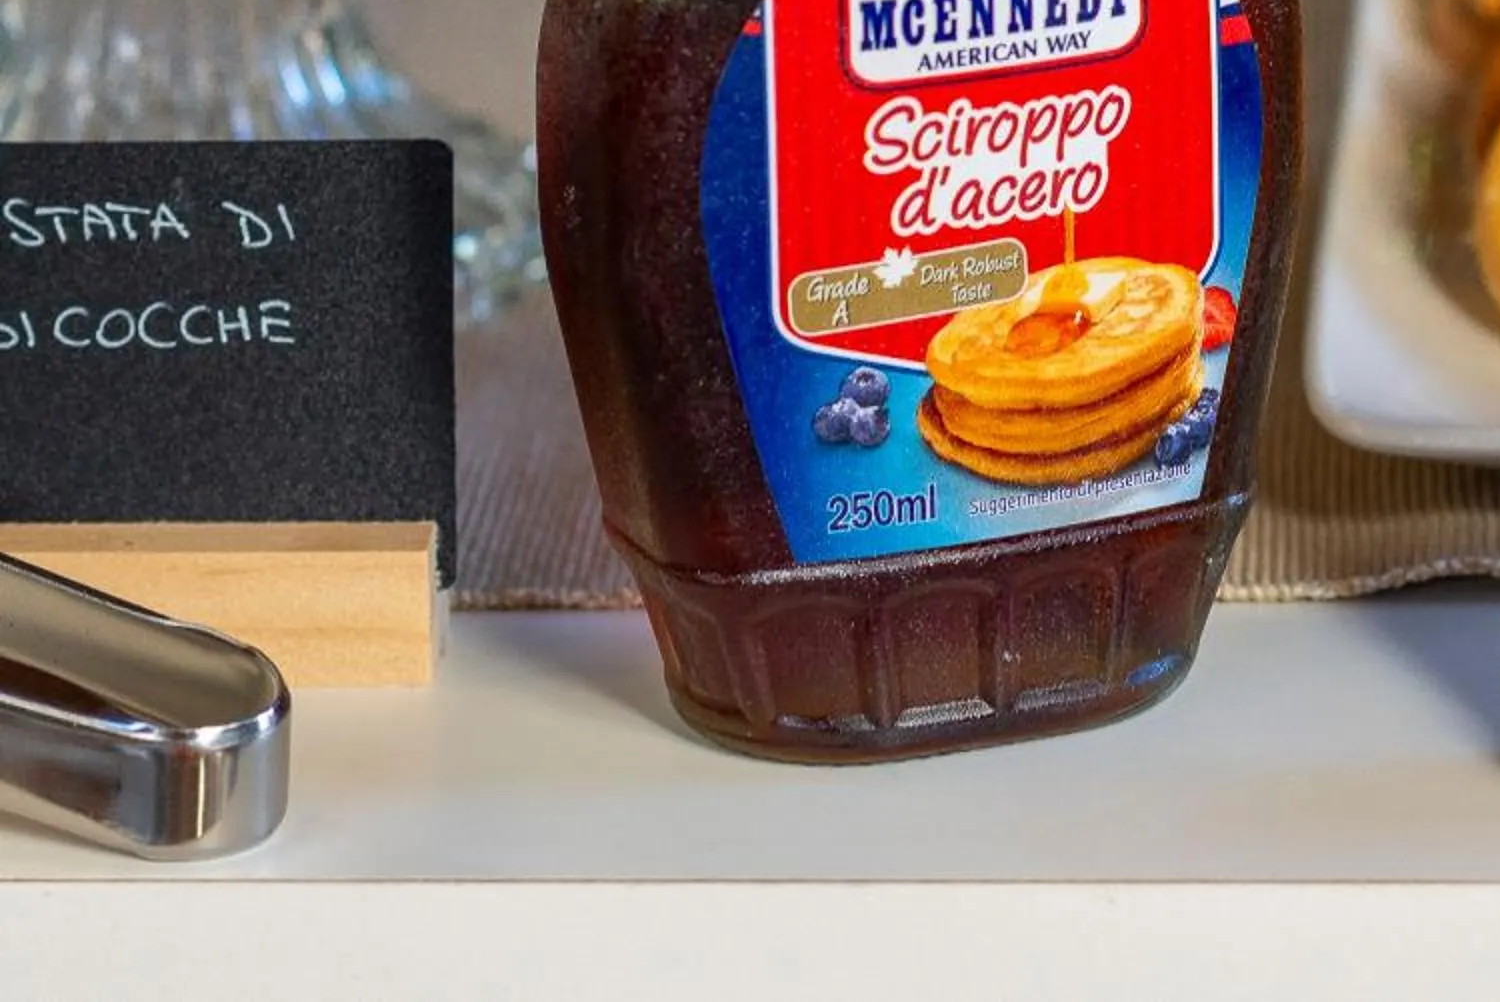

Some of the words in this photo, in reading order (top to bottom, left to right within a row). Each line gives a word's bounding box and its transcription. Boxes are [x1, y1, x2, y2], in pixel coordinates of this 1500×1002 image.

[916, 40, 1038, 73] AMERICAN
[1046, 30, 1093, 56] WAY
[868, 89, 1129, 169] Sciroppo
[896, 159, 1103, 230] d'acero
[221, 201, 297, 249] DI
[919, 260, 961, 286] Dark
[963, 248, 1022, 278] Robust
[807, 273, 870, 303] Grade
[951, 282, 993, 305] Taste
[832, 299, 849, 327] A
[826, 482, 938, 534] 250ml
[968, 484, 1073, 517] Suggerimento
